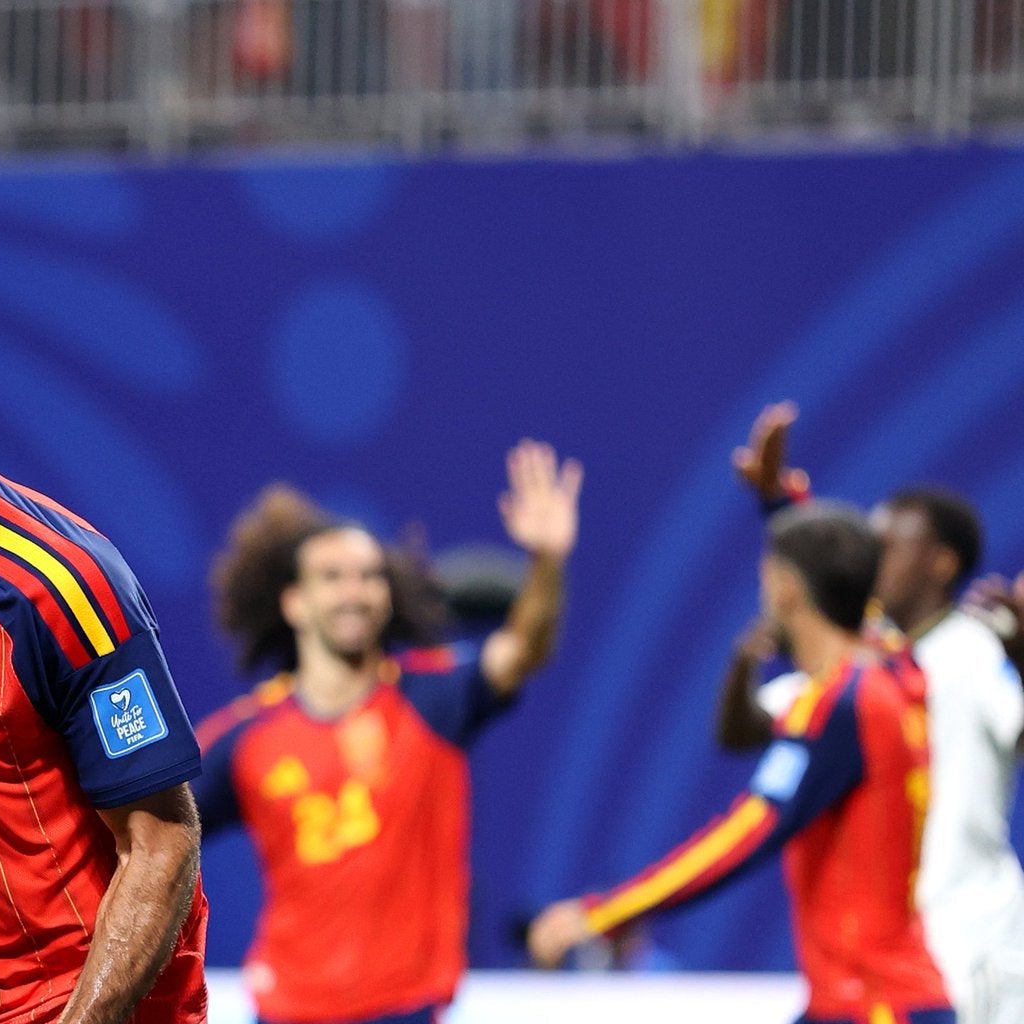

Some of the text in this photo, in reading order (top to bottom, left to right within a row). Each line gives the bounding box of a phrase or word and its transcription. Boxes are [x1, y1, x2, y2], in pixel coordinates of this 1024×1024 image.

[110, 704, 143, 728] Unite For
[116, 716, 147, 740] PEACE
[126, 733, 144, 745] FIFA
